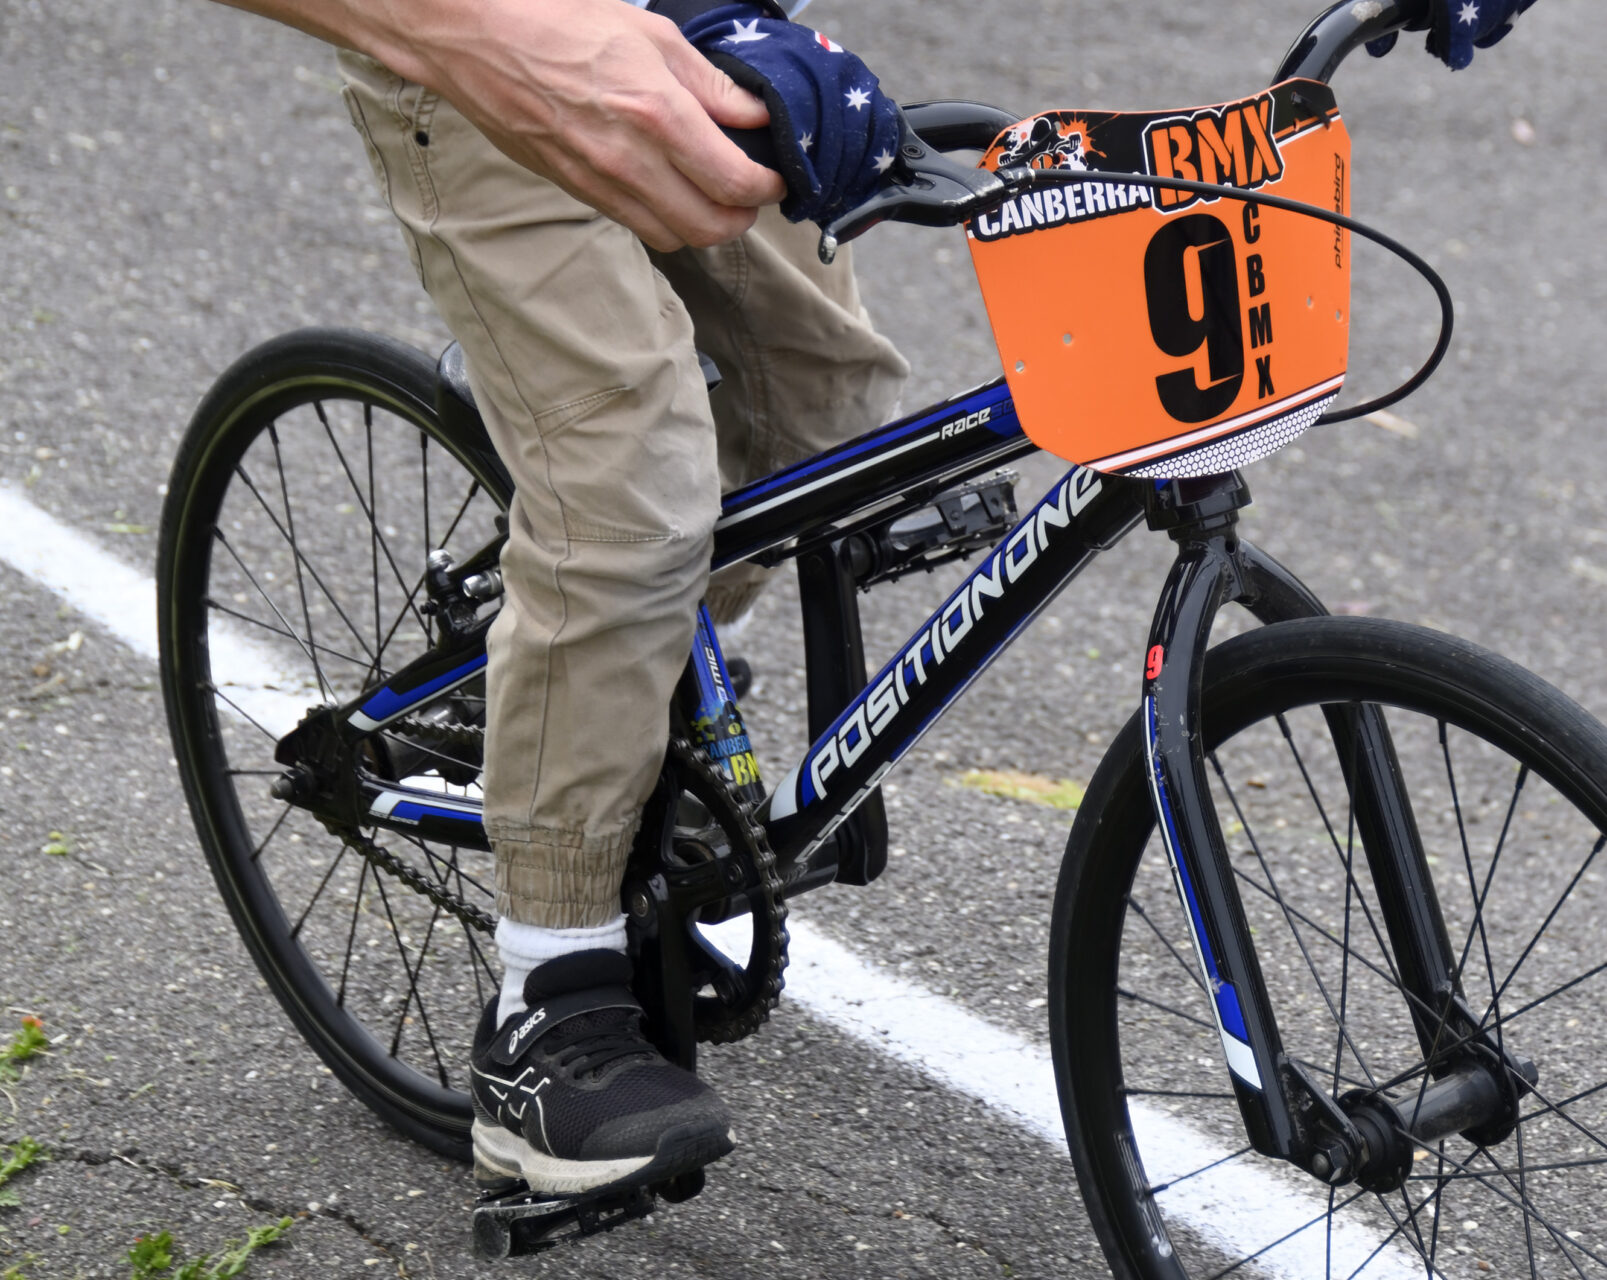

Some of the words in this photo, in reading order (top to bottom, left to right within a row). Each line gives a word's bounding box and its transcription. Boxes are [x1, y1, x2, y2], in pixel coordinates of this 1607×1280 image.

[1151, 99, 1280, 207] BMX
[978, 181, 1151, 236] CANBERRA
[1144, 213, 1245, 423] 9
[1146, 644, 1164, 680] 9
